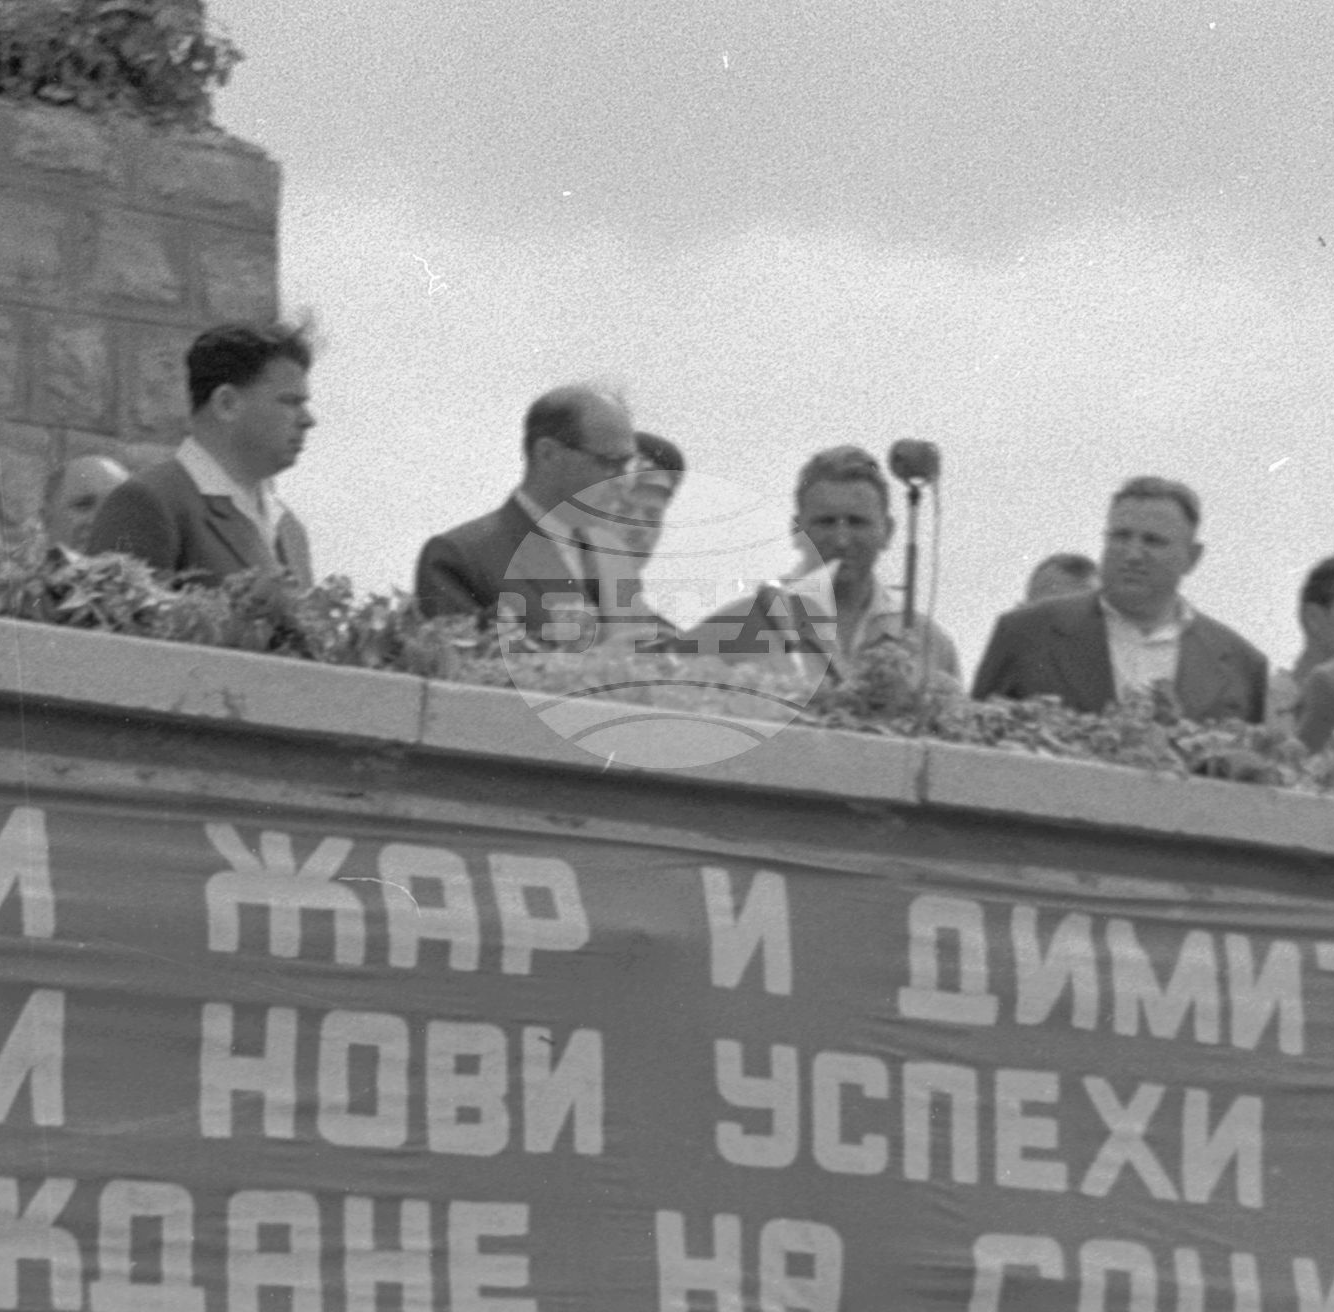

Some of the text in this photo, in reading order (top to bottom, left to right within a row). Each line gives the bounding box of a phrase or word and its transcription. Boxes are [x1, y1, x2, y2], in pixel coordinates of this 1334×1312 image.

[203, 822, 591, 974] ЖАР
[700, 865, 793, 996] И
[198, 1002, 605, 1157] НОВИ
[713, 1037, 1267, 1209] УСПЕХИ
